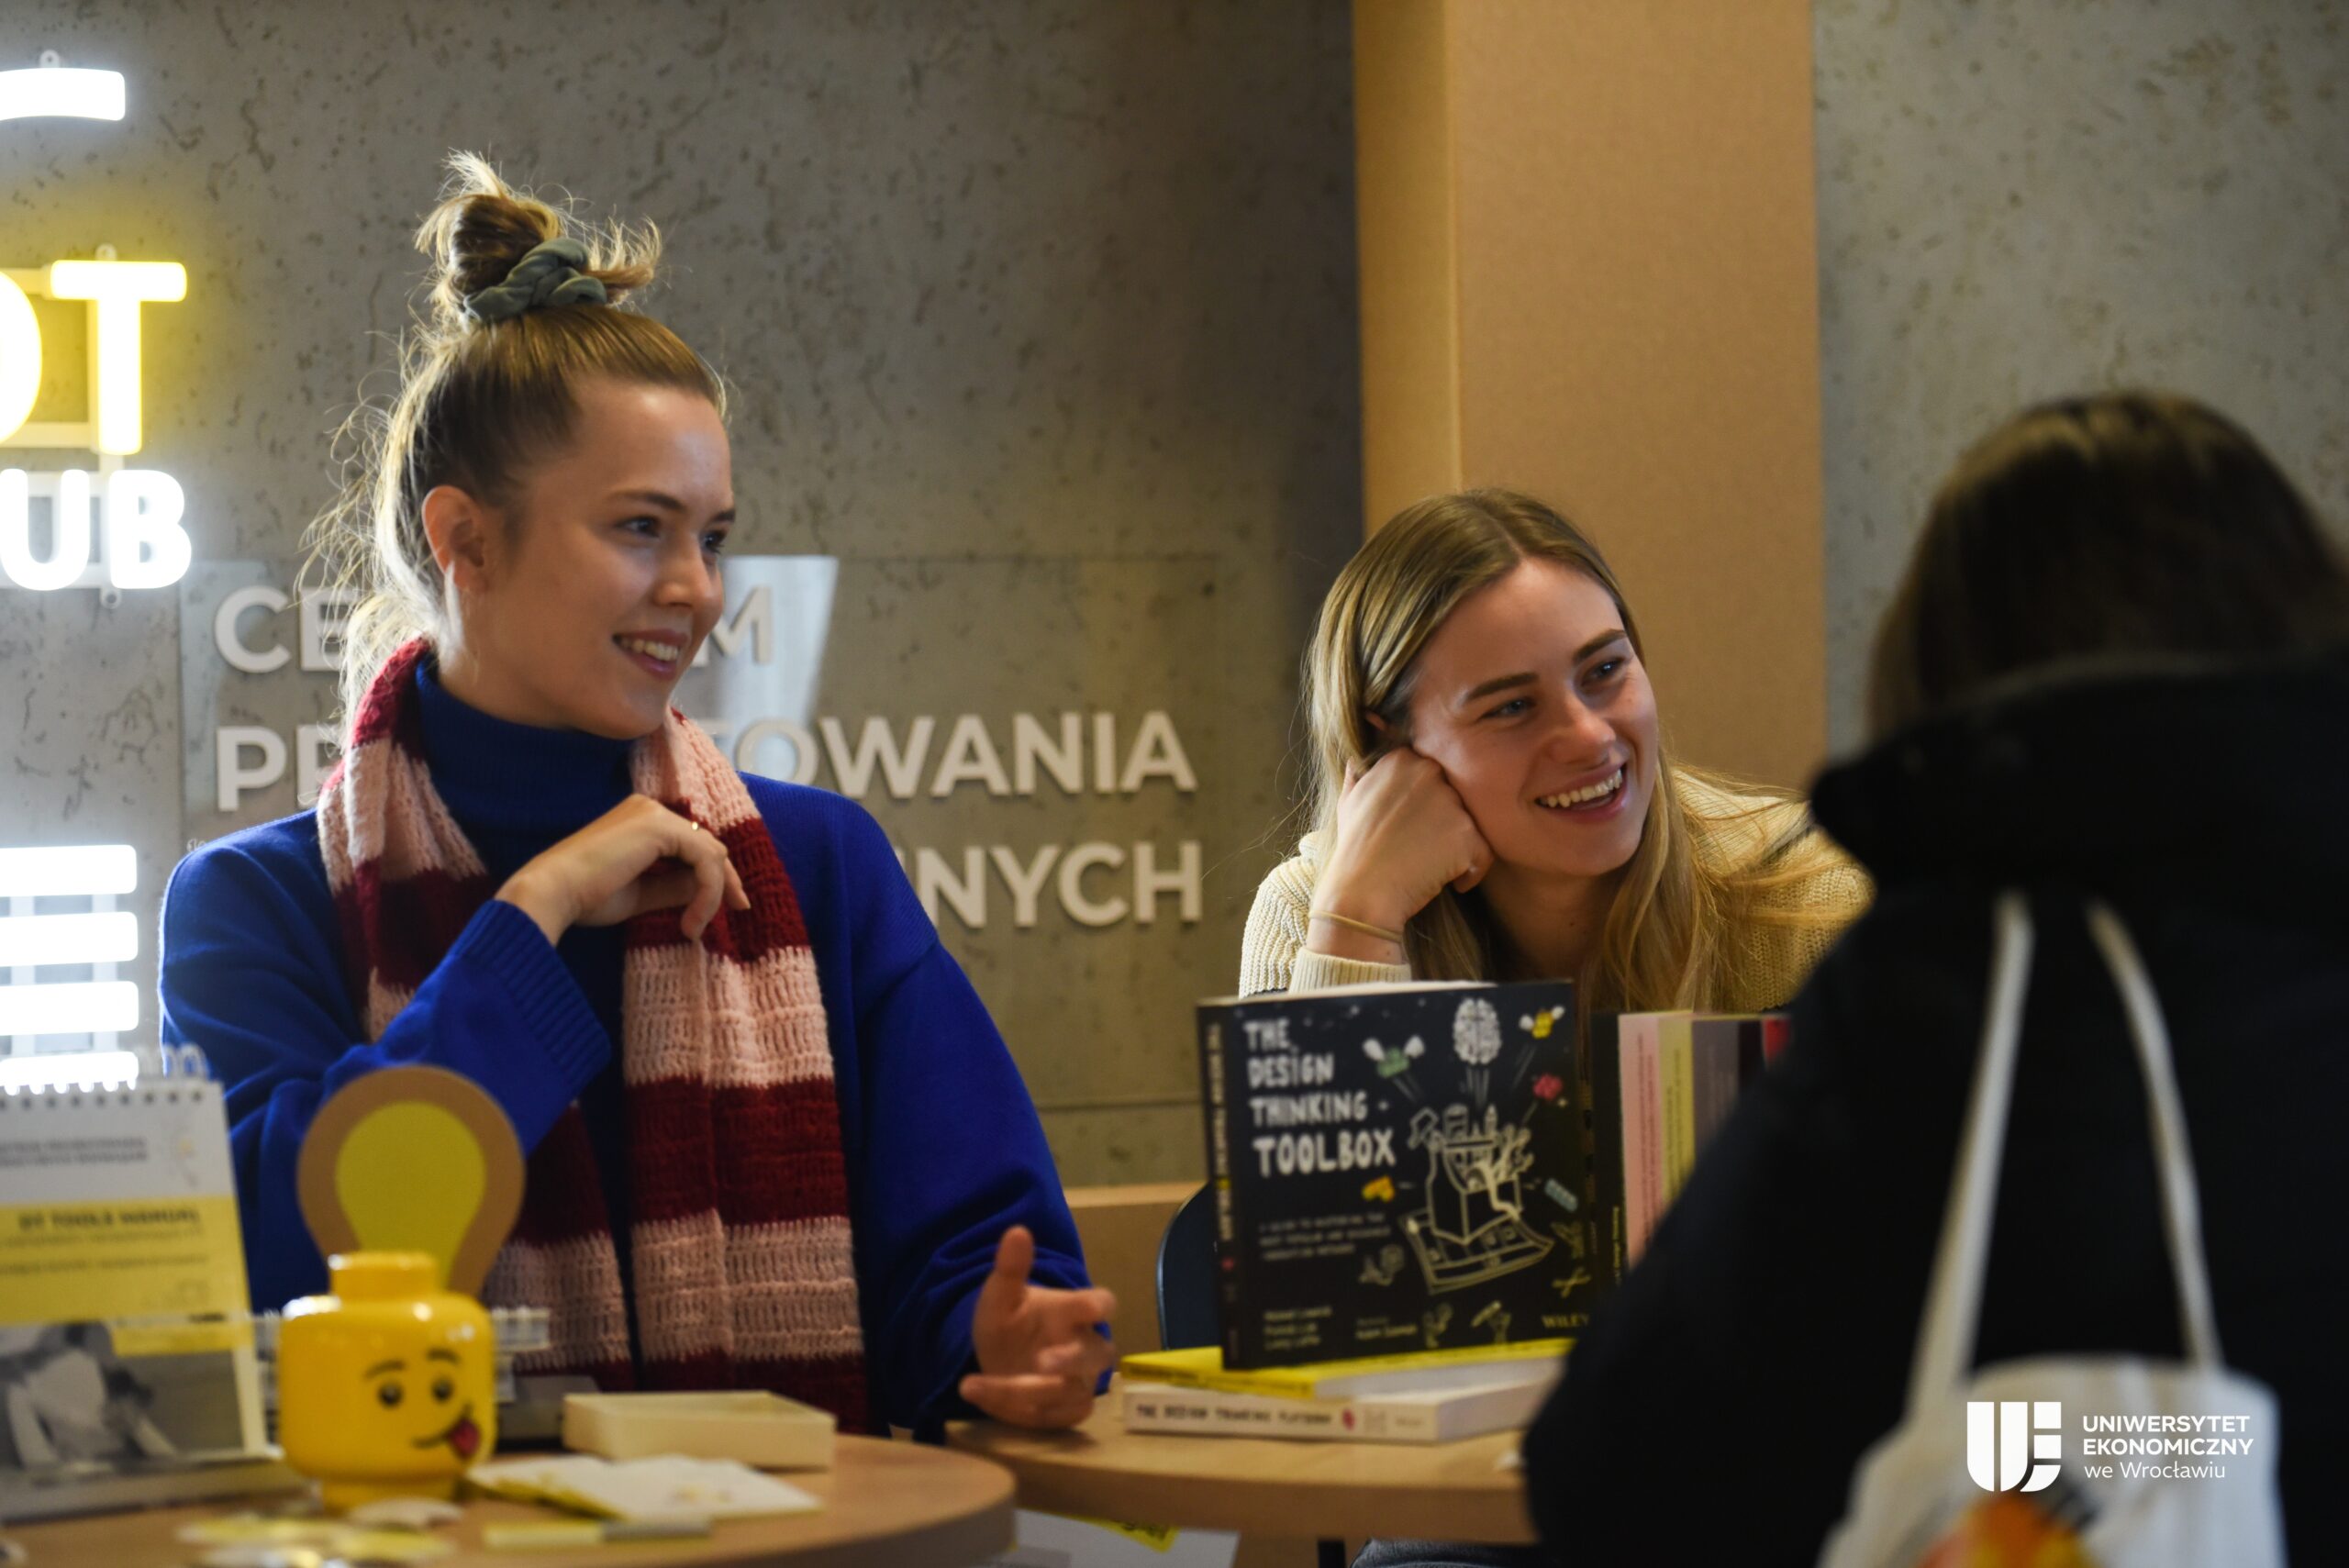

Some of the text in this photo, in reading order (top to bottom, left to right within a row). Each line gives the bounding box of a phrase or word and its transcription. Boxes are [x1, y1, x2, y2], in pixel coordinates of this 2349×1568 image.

[896, 840, 1202, 929] NYCH
[1243, 1018, 1290, 1051] THE
[1247, 1054, 1335, 1089] DESIGN
[1249, 1091, 1368, 1128] THINKING
[1252, 1129, 1397, 1177] TOOLBOX
